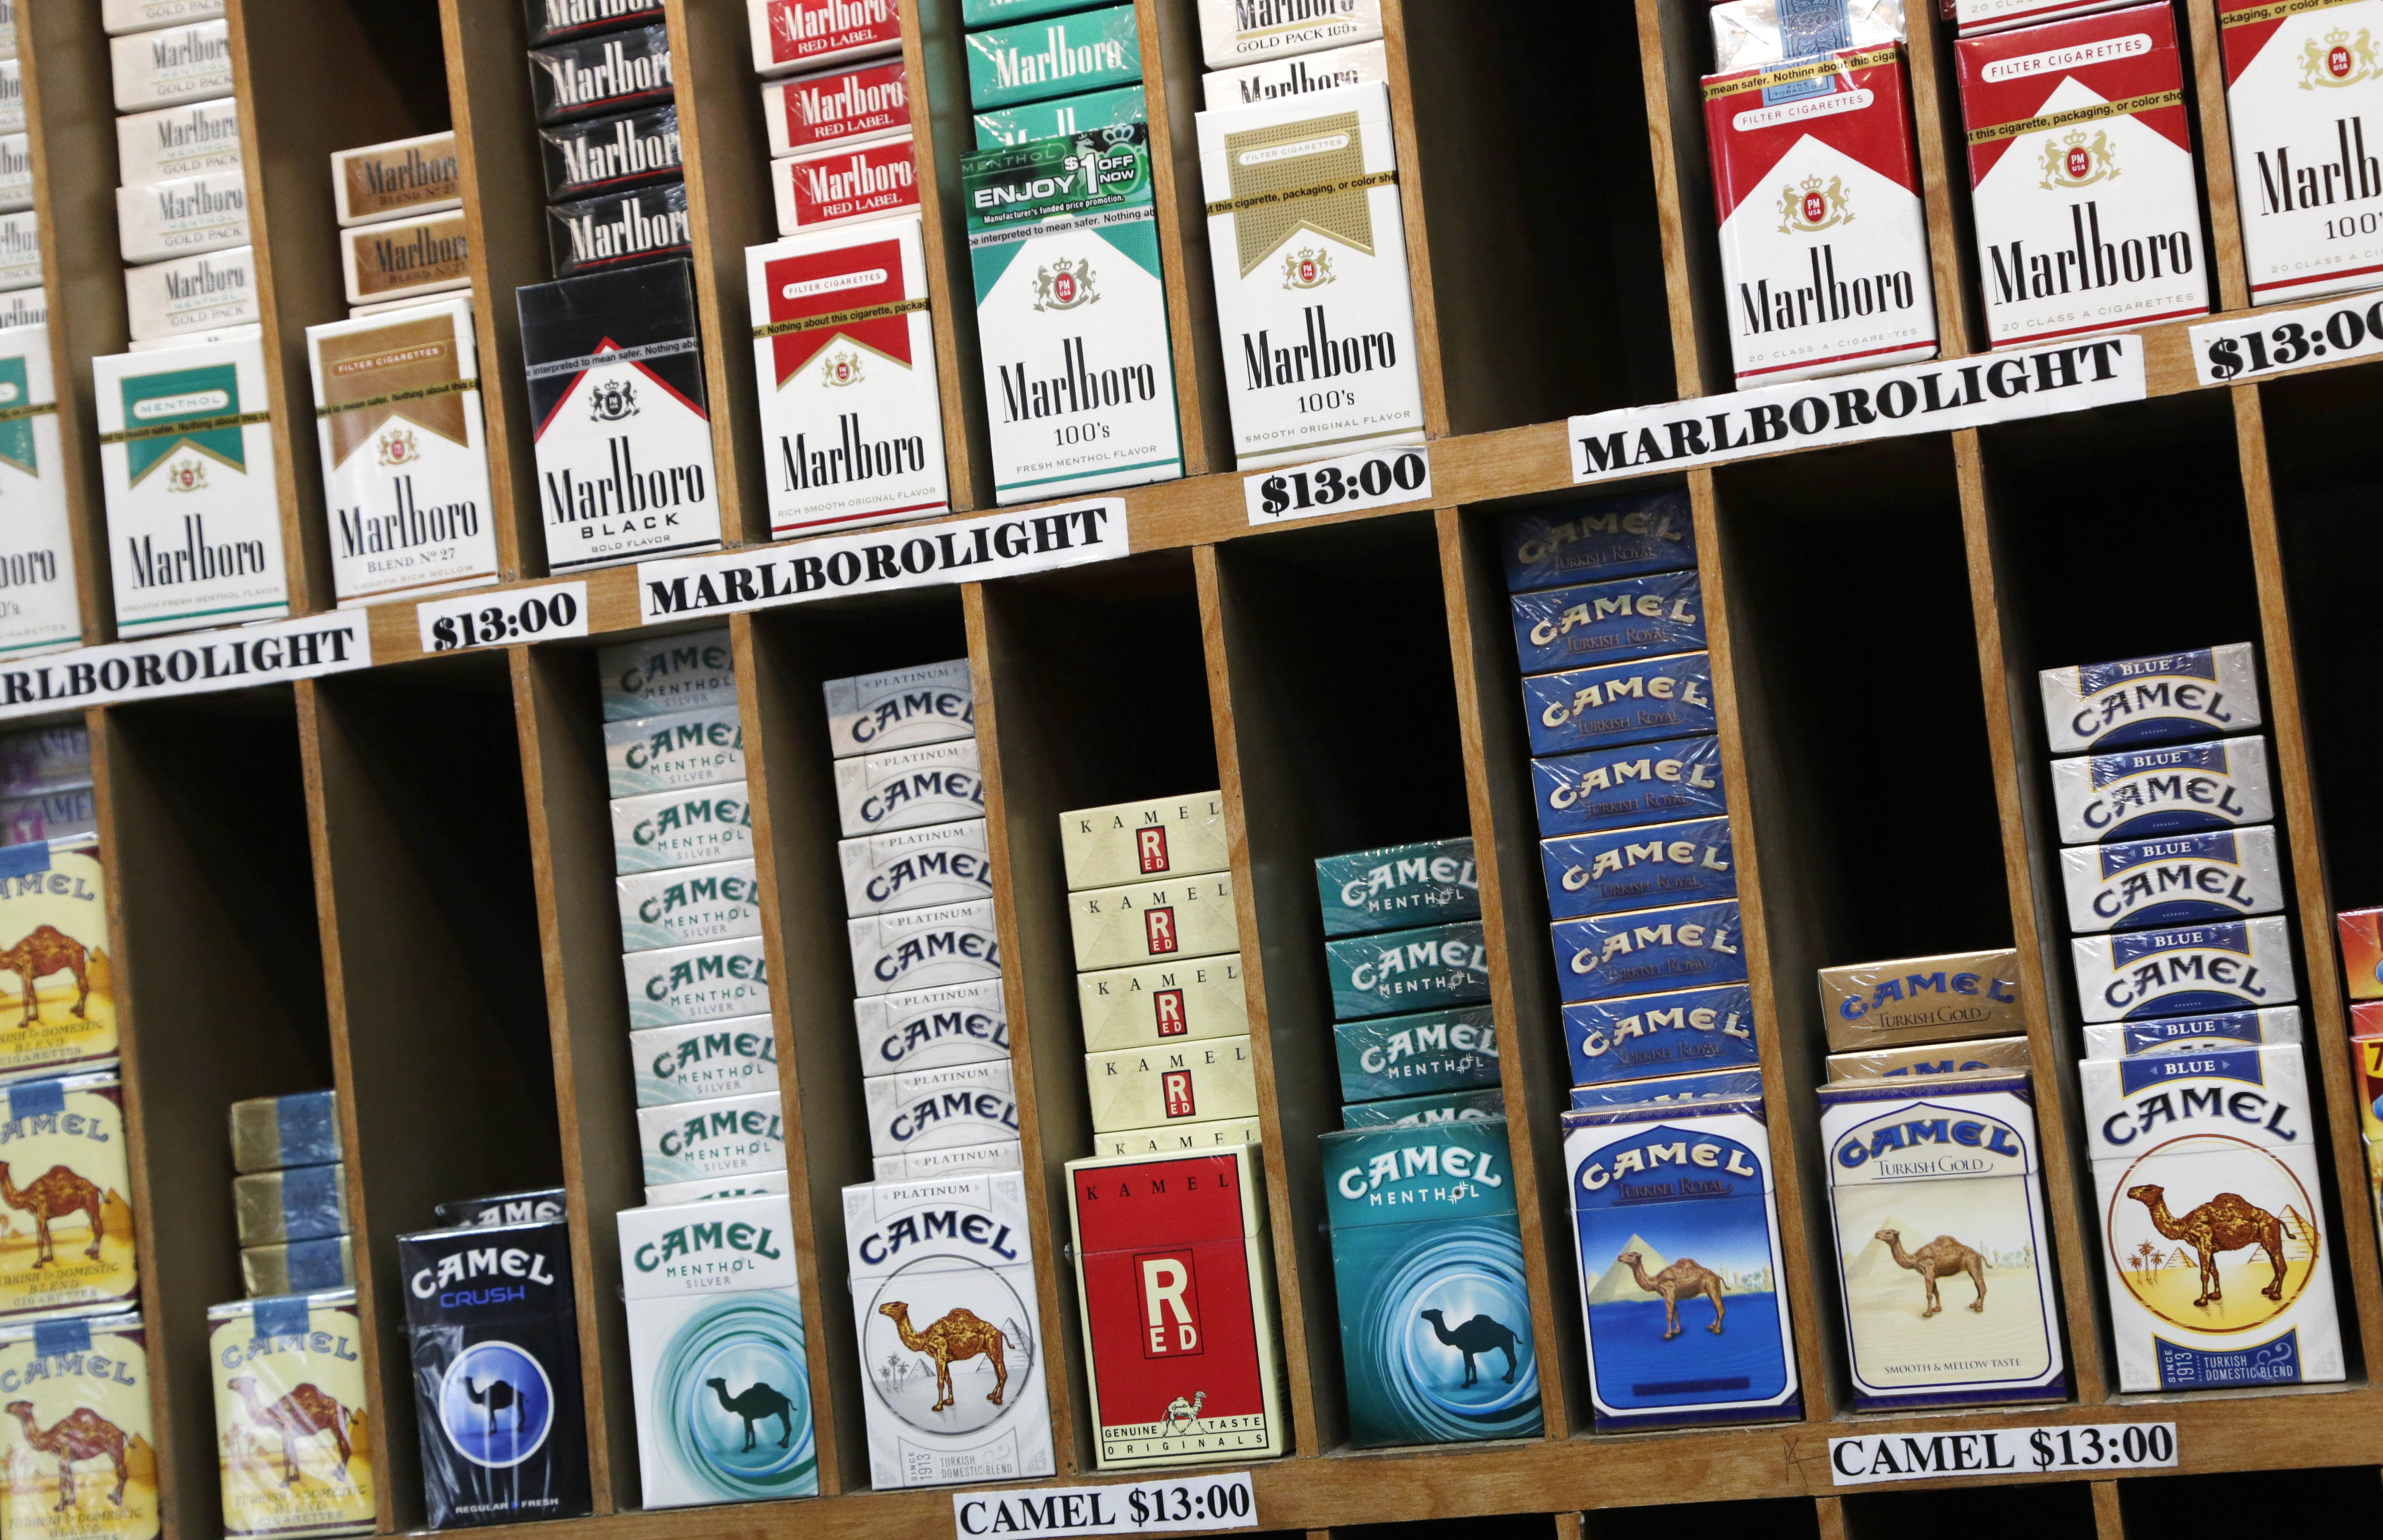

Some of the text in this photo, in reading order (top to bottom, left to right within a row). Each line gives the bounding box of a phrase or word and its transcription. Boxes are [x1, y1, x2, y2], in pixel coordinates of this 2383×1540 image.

[1236, 28, 1323, 53] GOLD PACK
[996, 25, 1121, 89] Marlboro
[1991, 40, 2142, 77] FILTER CIGARETTES
[1742, 76, 1770, 89] safer.
[1774, 68, 1814, 82] Nothing
[1817, 62, 1847, 73] about
[801, 76, 903, 126] Marlboro
[1743, 95, 1864, 125] FILTER CIGARETTES
[815, 114, 894, 138] RED LABEL
[1999, 105, 2113, 134] cigarette, packaging,
[962, 151, 1056, 173] MENTHOL
[1098, 155, 1134, 170] OFF
[1246, 139, 1342, 161] FILTER CIGARETTES
[974, 153, 1099, 209] ENJOY $1
[1100, 170, 1134, 184] NOW
[2253, 116, 2383, 216] Marlb
[984, 194, 1124, 223] Manufacturer's funded price promotion.
[1215, 177, 1375, 212] this cigarette, packaging, or color
[1808, 198, 1820, 209] PM
[981, 211, 1147, 243] interpreted to mean safer. Nothing
[1987, 201, 2193, 306] Marlboro
[164, 262, 244, 301] Marlboro
[789, 273, 881, 294] FILTER CIGARETTES
[1059, 279, 1070, 289] PM
[1737, 244, 1914, 336] Marlboro
[171, 306, 244, 326] GOLD PACK
[768, 306, 892, 334] Nothing about this cigarette,
[1241, 305, 1396, 390] Marlboro
[1773, 346, 1813, 358] CLASS
[1838, 328, 1917, 348] CIGARETTES
[338, 348, 439, 372] FILTER CIGARETTES
[532, 343, 679, 376] interpreted to mean safer. Nothing
[998, 336, 1155, 423] Marlboro
[140, 396, 220, 413] MENTHOL
[1297, 390, 1354, 414] 100's
[1578, 339, 2123, 475] MARLBOROLIGHT
[1054, 422, 1110, 446] 100's
[1246, 411, 1411, 442] SMOOTH ORIGINAL FLAVOR
[779, 412, 924, 491] Marlboro
[1017, 445, 1156, 473] FRESH MENTHOL FLAVOR
[544, 435, 705, 525] Marlboro
[1261, 453, 1426, 518] $13:00
[337, 475, 478, 559] Marlboro
[778, 487, 936, 517] RICH SMOOTH ORIGINAL FLAVOR
[582, 512, 680, 539] BLACK
[127, 514, 265, 590] Marlboro
[592, 535, 670, 552] BOLD FLAVOR
[368, 548, 455, 573] BLEND 27
[648, 508, 1107, 617] MARLBOROLIGHT
[432, 593, 577, 651] $13:00
[1530, 595, 1696, 646] CAMEL
[0, 628, 353, 706] RLBOROLIGHT
[2122, 660, 2170, 676] BLUE
[2072, 683, 2231, 737] CAMEL
[884, 748, 958, 766] PLATINUM
[2143, 842, 2191, 857] BLUE
[1562, 842, 1728, 891] CAMEL
[1341, 857, 1478, 907] CAMEL
[2093, 865, 2254, 919] CAMEL
[1840, 972, 2015, 1020] CAMEL
[653, 1033, 777, 1079] CAMEL
[2165, 1060, 2215, 1074] BLUE
[678, 1063, 764, 1084] MENTHOL
[697, 1081, 740, 1093] SILVER
[890, 1092, 1019, 1142] CAMEL
[2103, 1087, 2297, 1146] CAMEL
[1838, 1118, 2019, 1169] CAMEL
[1338, 1145, 1502, 1200] CAMEL
[1582, 1142, 1754, 1190] CAMEL
[1874, 1156, 1983, 1176] TURKISH GOLD
[893, 1184, 970, 1200] PLATINUM
[1370, 1181, 1479, 1206] MENTHOL
[635, 1221, 780, 1273] CAMEL
[859, 1210, 1017, 1265] CAMEL
[411, 1247, 554, 1299] CAMEL
[667, 1259, 754, 1278] MENTHOL
[686, 1276, 731, 1288] SILVER
[440, 1285, 525, 1308] CRUSH
[222, 1331, 357, 1369] CAMEL
[2204, 1355, 2247, 1368] TURKISH
[0, 1355, 135, 1392] CAMEL
[1885, 1364, 1931, 1375] SMOOTH
[1944, 1360, 1988, 1370] MELLOW
[1990, 1358, 2021, 1367] TASTE
[2165, 1349, 2176, 1383] SINCE
[2175, 1352, 2192, 1383] 1913
[2206, 1365, 2293, 1381] DOMESTIC BLEND
[1105, 1417, 1261, 1438] GENUINE TASTE
[1108, 1434, 1262, 1455] ORIGINALS
[1833, 1425, 2173, 1476] CAMEL $13:00
[908, 1451, 918, 1481] SINCE
[916, 1454, 931, 1481] 1913
[940, 1456, 975, 1467] TURKISH
[942, 1463, 1012, 1478] DOMESTIC BLEND
[456, 1497, 558, 1514] REGULAR FRESH
[960, 1483, 1249, 1535] CAMEL $13:00
